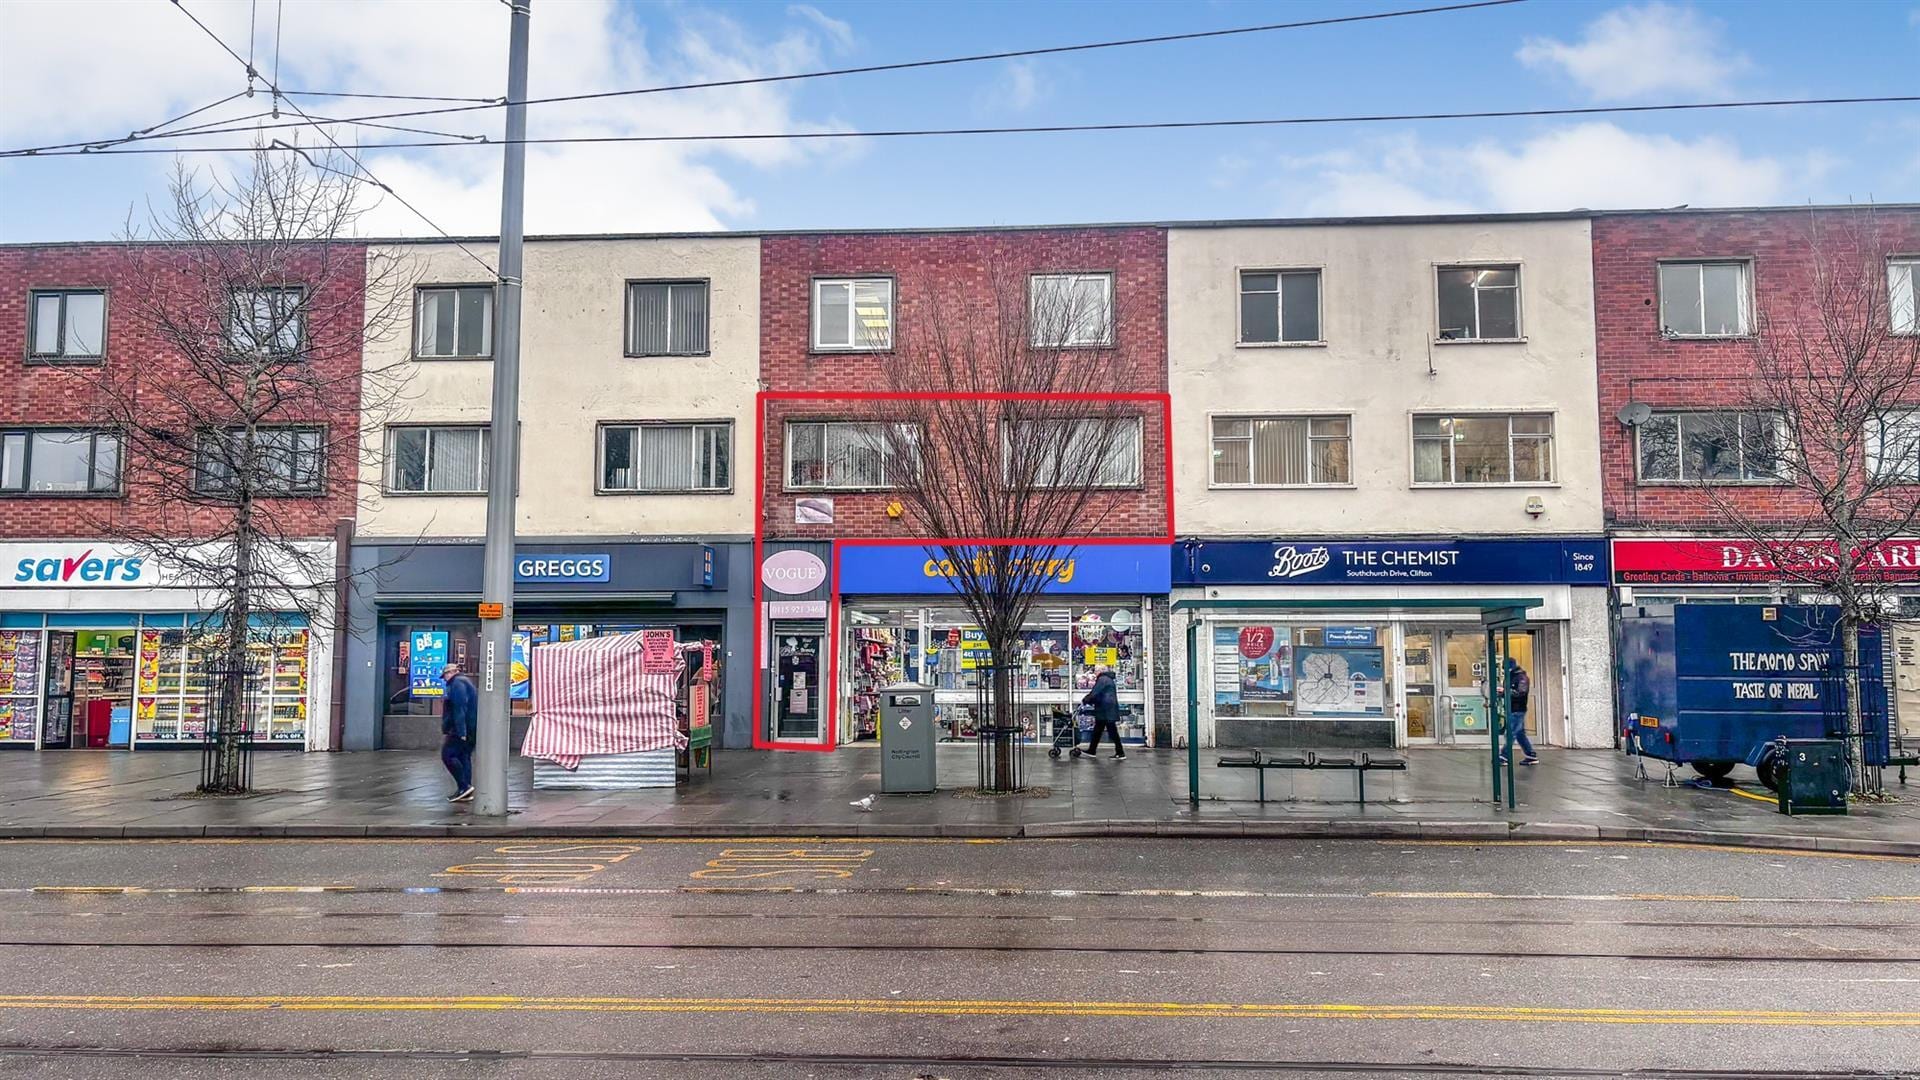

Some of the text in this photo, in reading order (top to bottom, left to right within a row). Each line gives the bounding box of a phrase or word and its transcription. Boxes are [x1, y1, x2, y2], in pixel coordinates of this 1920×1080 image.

[1268, 546, 1459, 577] Boots THE CHEMIST
[1573, 552, 1594, 560] Since
[14, 549, 143, 582] savers
[518, 559, 603, 576] GREGGS
[1574, 563, 1594, 571] 1849
[765, 567, 817, 580] VOGUE
[1623, 572, 1659, 582] Greeting
[1662, 572, 1686, 581] Cards
[1692, 572, 1729, 581] Balloons
[1736, 572, 1781, 581] Invitations
[1884, 571, 1919, 581] Banners
[646, 631, 671, 639] JOHN'S
[964, 631, 983, 640] Buy
[1246, 632, 1264, 643] 1/2
[1729, 652, 1756, 671] THE
[1756, 652, 1796, 671] MOMO
[1733, 682, 1819, 699] TASTE OF NEPAL
[1799, 752, 1806, 761] 3
